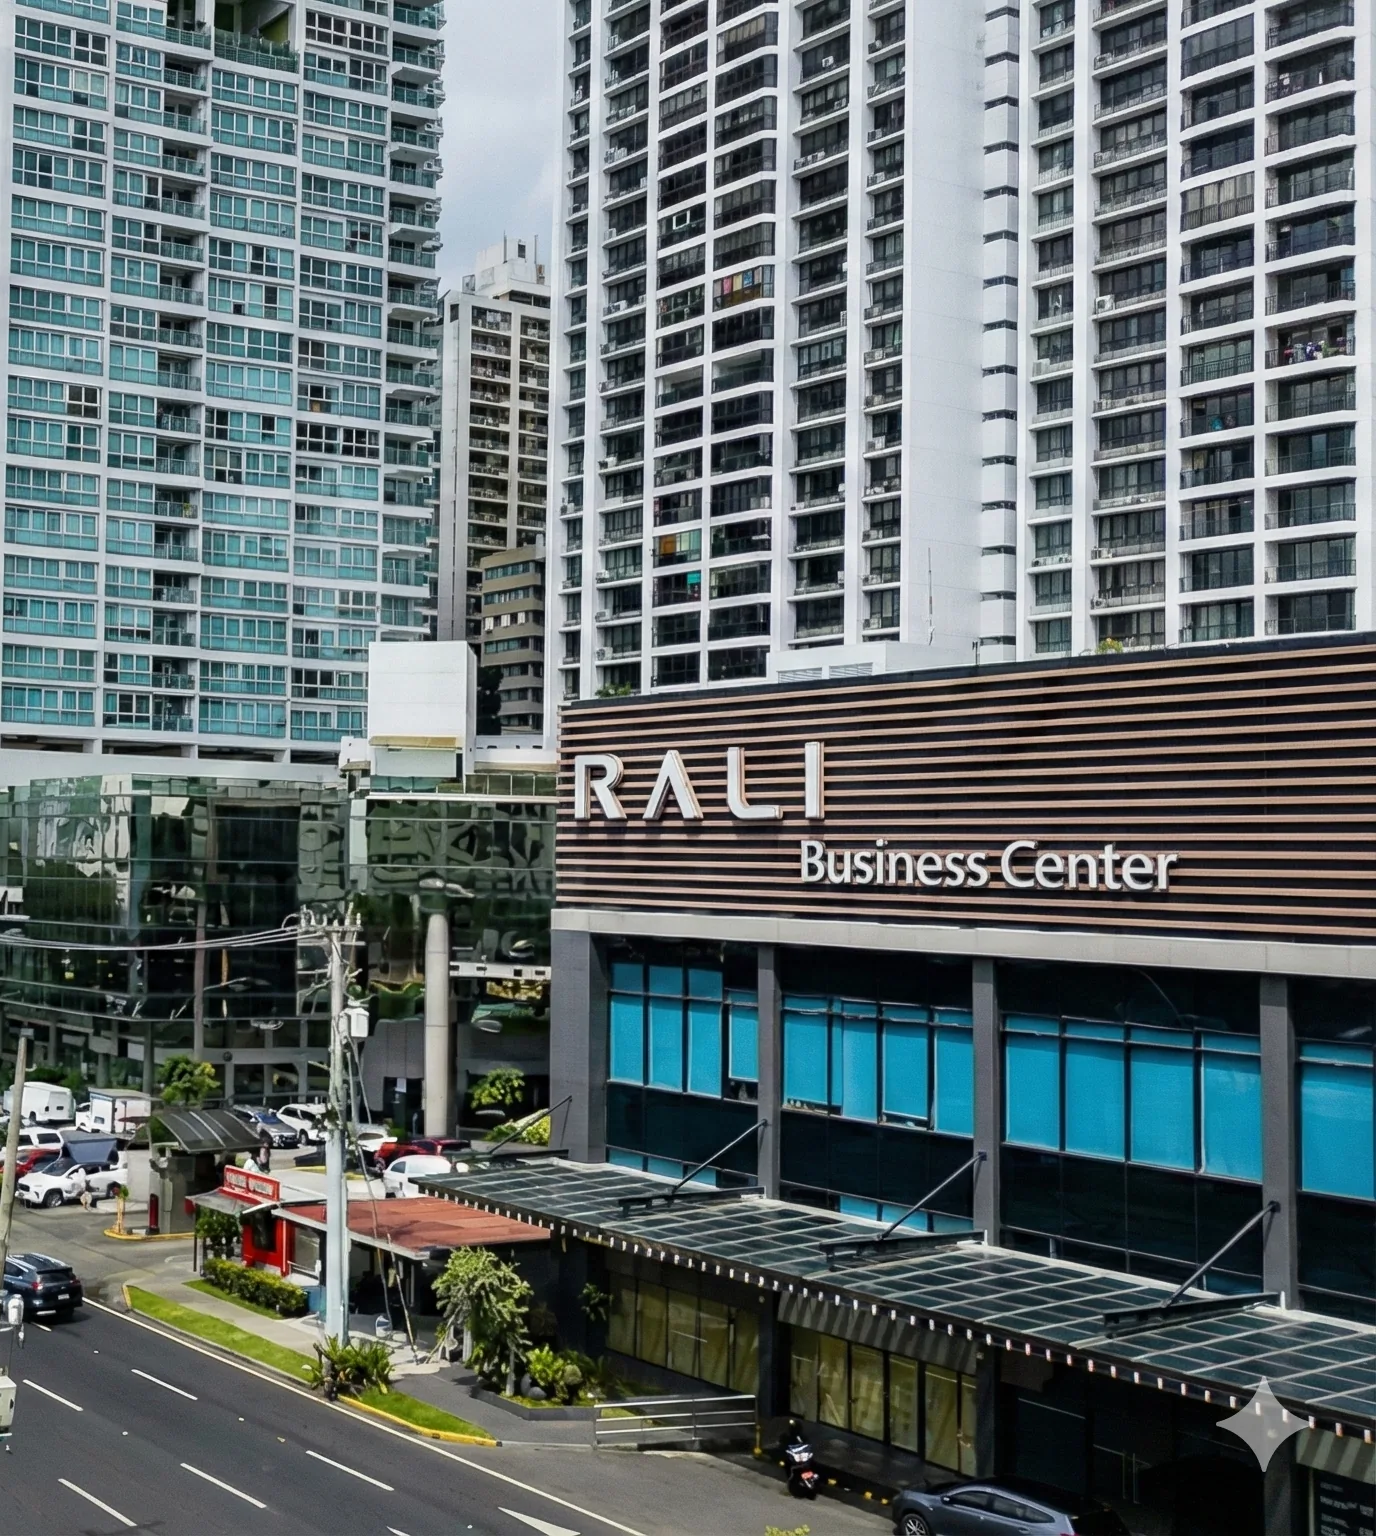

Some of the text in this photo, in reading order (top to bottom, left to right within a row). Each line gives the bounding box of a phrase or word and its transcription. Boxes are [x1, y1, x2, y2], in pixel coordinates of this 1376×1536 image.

[574, 741, 825, 820] RALI
[800, 838, 1180, 891] Business Center
